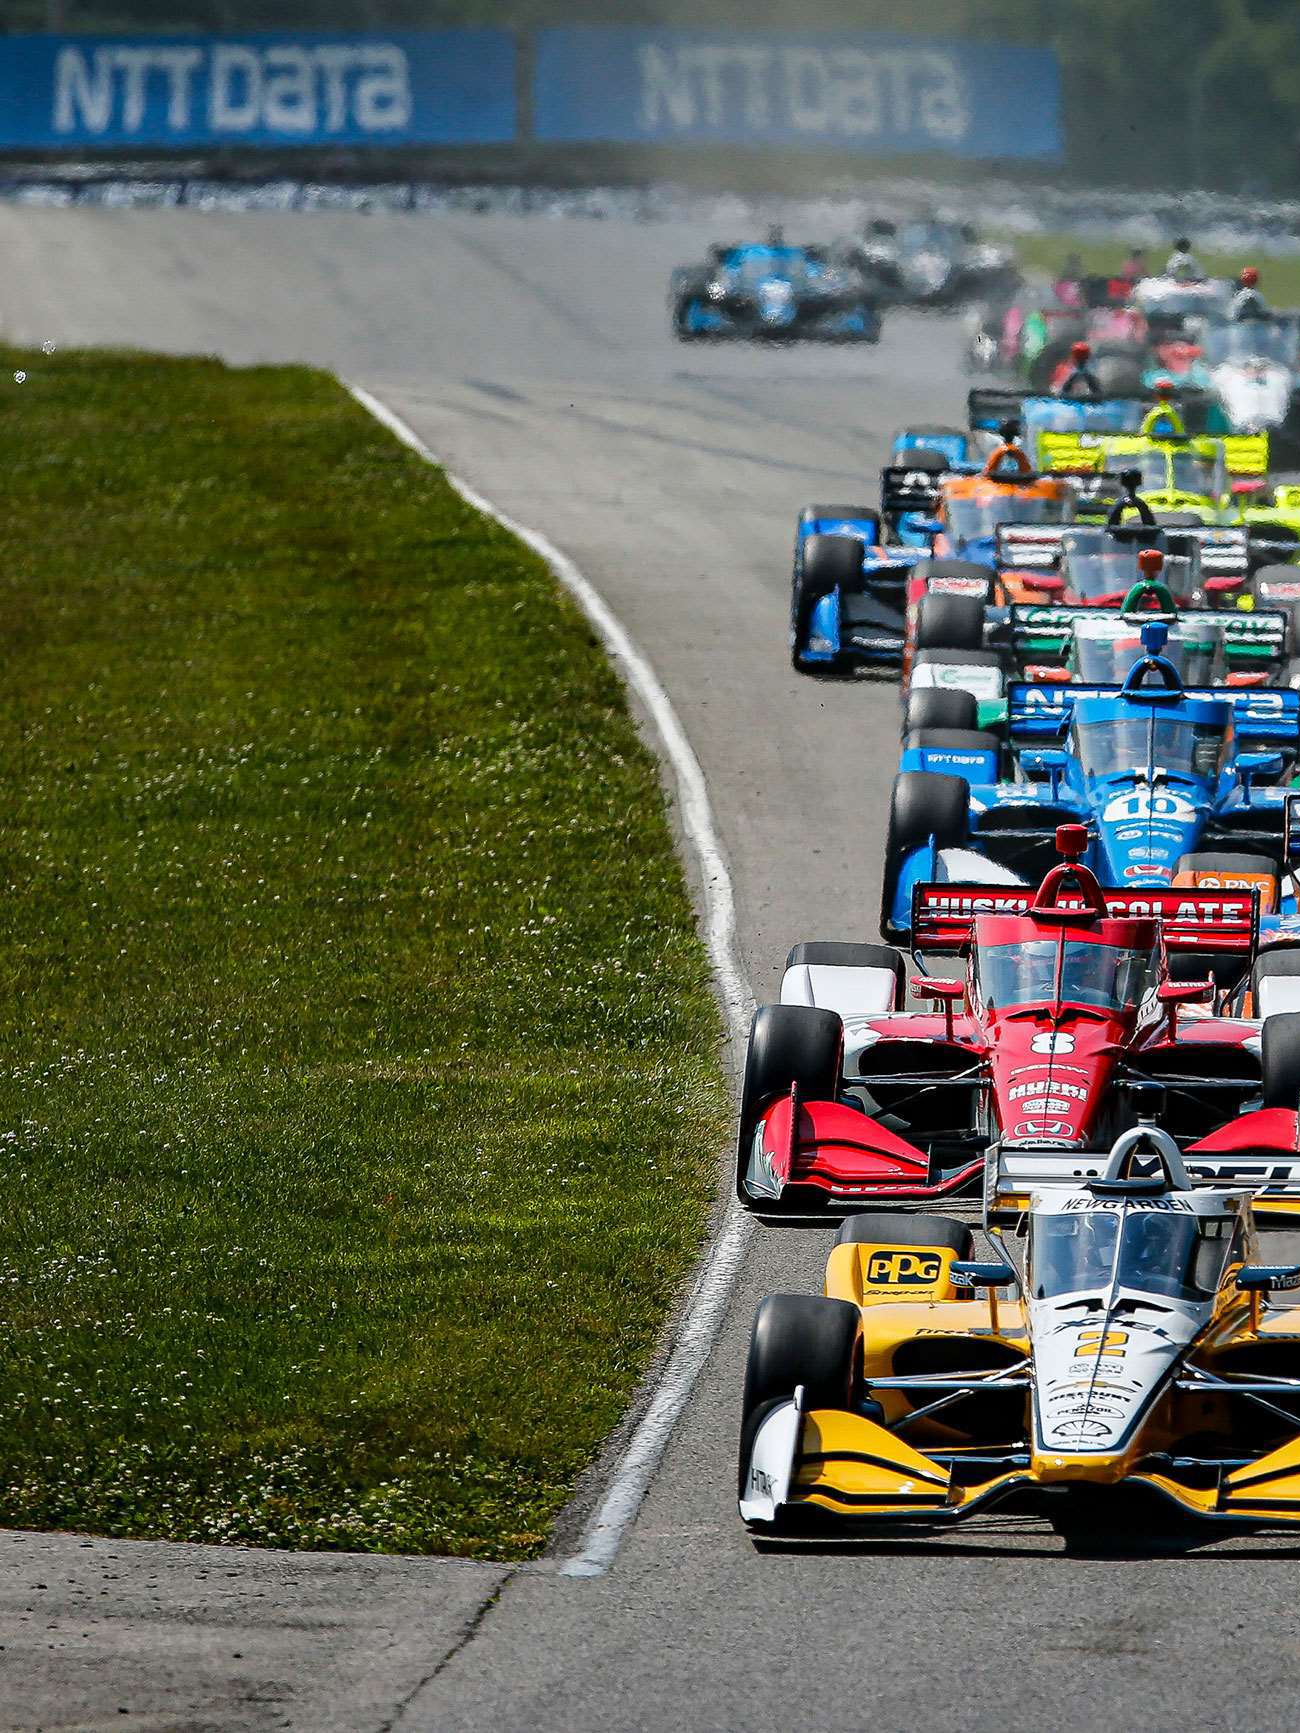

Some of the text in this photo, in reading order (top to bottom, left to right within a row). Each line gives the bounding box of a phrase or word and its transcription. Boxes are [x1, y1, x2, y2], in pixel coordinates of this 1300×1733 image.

[53, 45, 199, 133] NTT
[640, 44, 774, 130] NTT
[1031, 1031, 1077, 1055] 8
[1061, 1198, 1195, 1213] NEWGARDEN
[869, 1254, 940, 1283] PPG
[1074, 1331, 1130, 1358] 2
